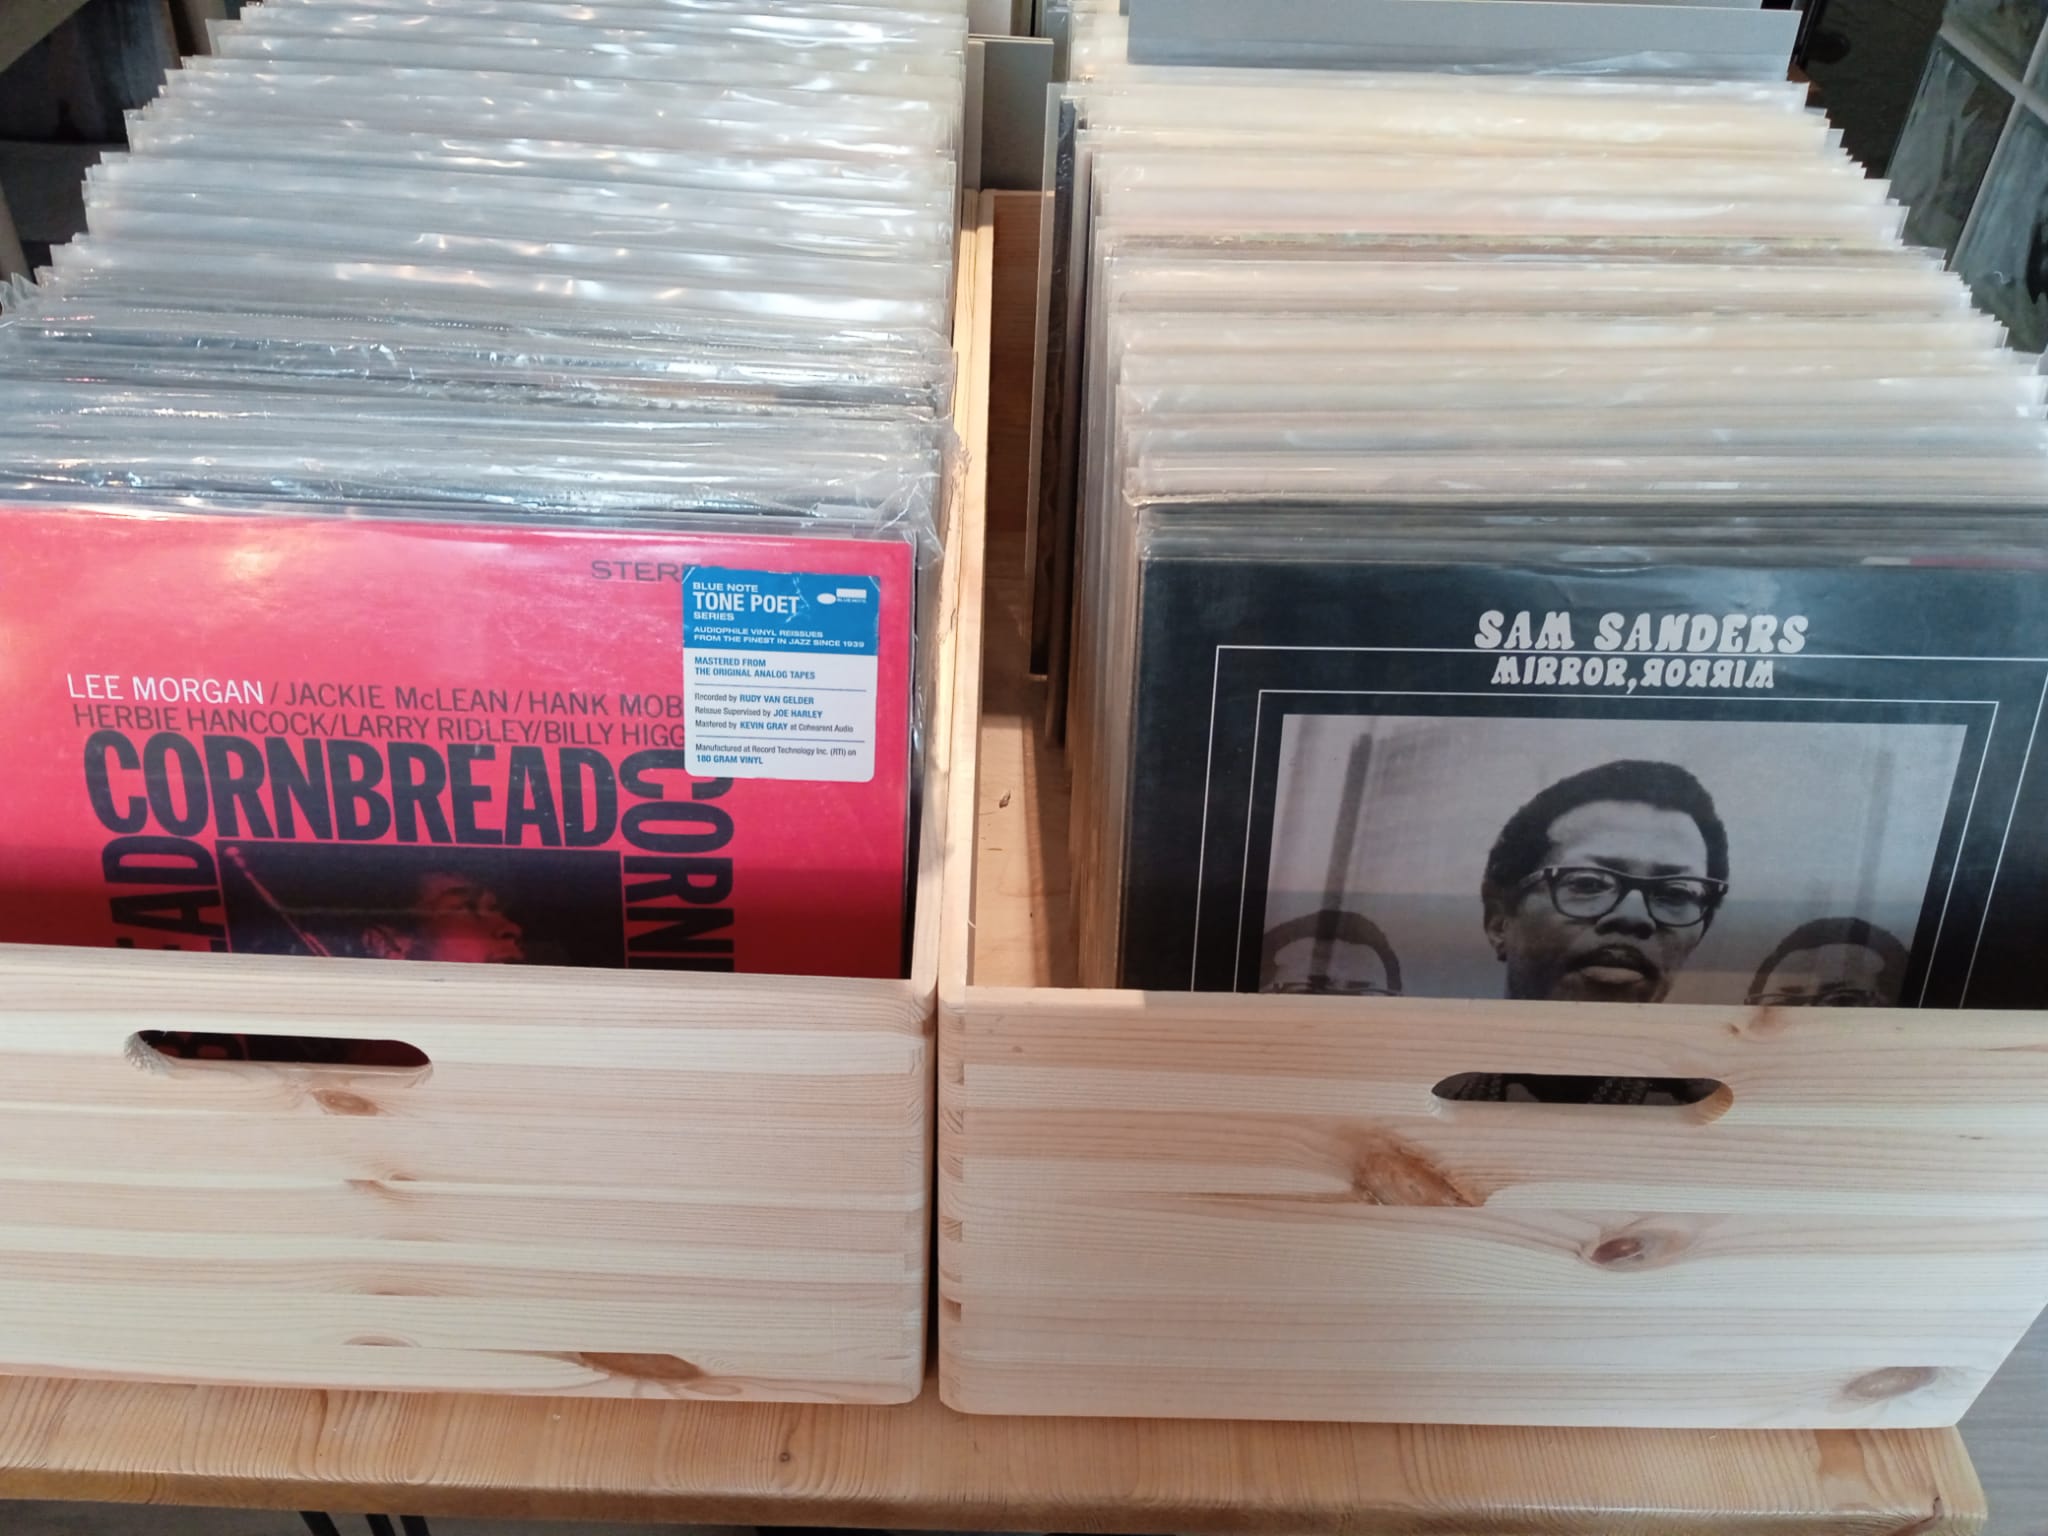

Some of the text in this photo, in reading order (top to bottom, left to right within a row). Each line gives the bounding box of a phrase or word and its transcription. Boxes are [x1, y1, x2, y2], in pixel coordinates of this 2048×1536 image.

[591, 559, 687, 583] STER
[693, 582, 758, 593] BLUE NOTE
[693, 591, 799, 614] TONE POET
[693, 611, 734, 621] SERIES
[694, 626, 823, 638] AUDIOPHILE VINYL REISSUES
[1474, 610, 1809, 653] SAM SANDERS
[694, 634, 720, 642] FROM
[723, 635, 741, 643] THE
[743, 636, 774, 644] FINEST
[777, 637, 787, 645] IN
[789, 638, 811, 646] JAZZ
[813, 639, 840, 647] SINCE
[694, 656, 766, 667] MASTERED FROM
[695, 667, 816, 680] THE ORIGINAL ANALOG TAPES
[67, 673, 124, 700] LEE
[132, 676, 264, 705] MORGAN
[284, 682, 385, 710] JACKIE
[395, 686, 508, 713] McLEAN
[529, 691, 609, 717] HANK
[619, 694, 683, 718] MOB
[694, 692, 814, 705] Recorded by RUDY VAN GELDER
[694, 706, 823, 719] Reissue Supervised by JOE HARLEY
[73, 704, 181, 732] HERBIE
[621, 722, 684, 748] HIGG
[695, 719, 727, 729] Mastered
[728, 721, 737, 730] by
[739, 721, 764, 730] KEVIN
[766, 722, 788, 731] GRAY
[790, 723, 797, 731] at
[834, 725, 854, 733] Audio
[695, 743, 742, 753] Manufactured
[743, 745, 751, 753] at
[752, 746, 776, 754] Record
[778, 746, 815, 756] Technology
[816, 748, 828, 756] Inc.
[830, 747, 847, 757] (RTI)
[696, 754, 763, 764] 180 GRAM VINYL
[84, 731, 619, 848] CORNBREAD
